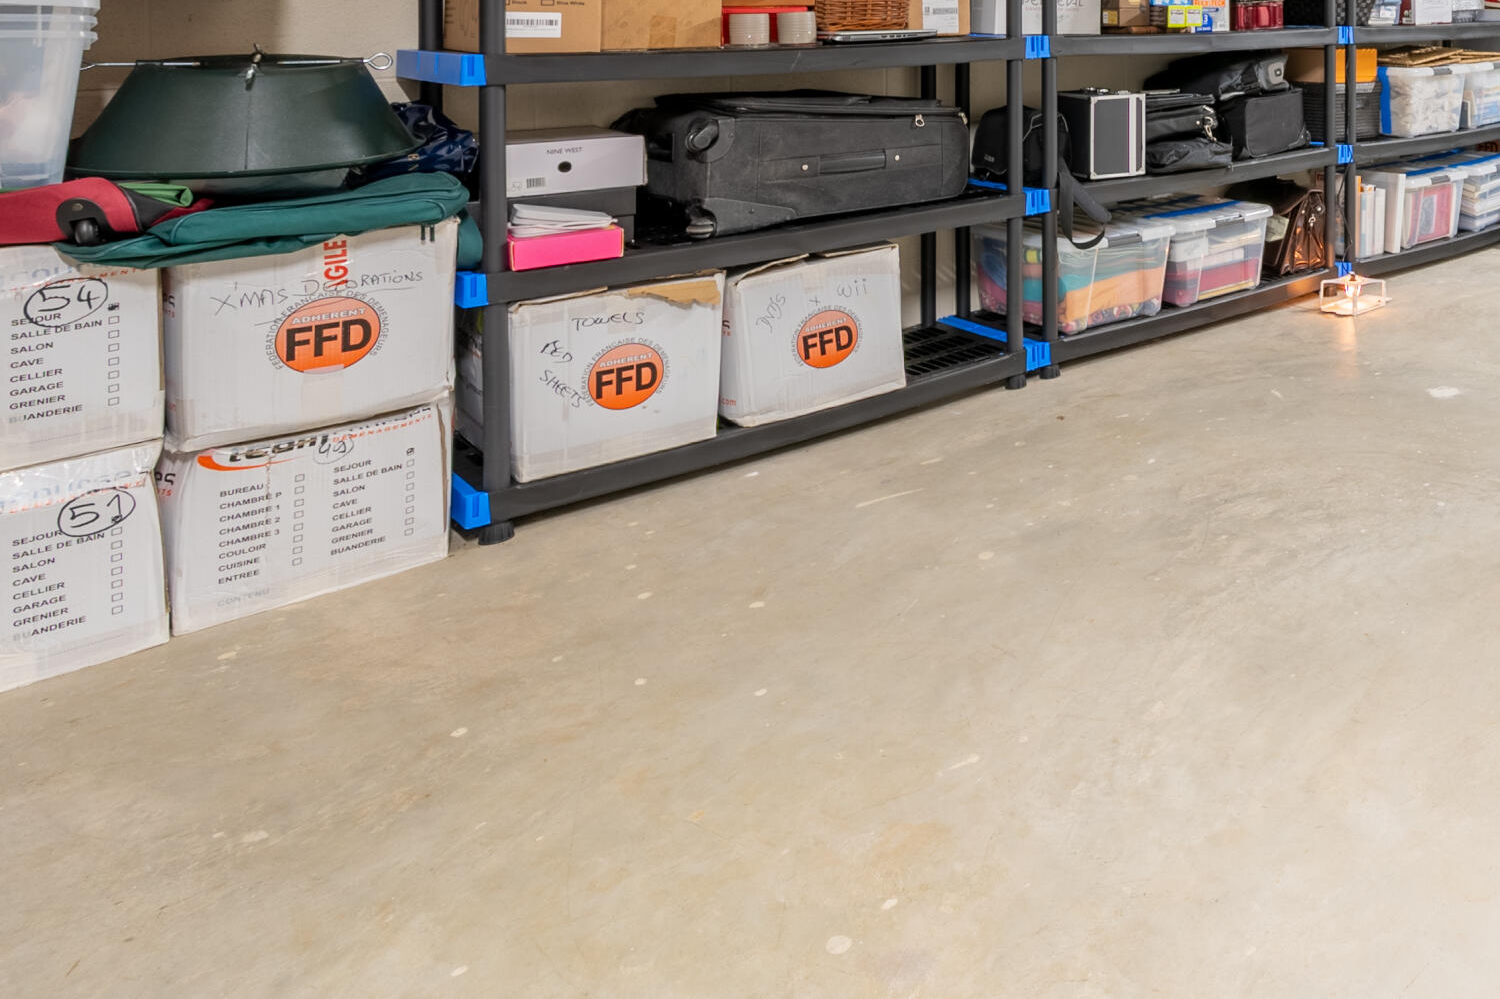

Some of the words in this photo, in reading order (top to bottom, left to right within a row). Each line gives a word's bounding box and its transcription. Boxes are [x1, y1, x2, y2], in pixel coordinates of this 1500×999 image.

[564, 146, 583, 154] WEST
[37, 284, 100, 312] 54
[11, 313, 61, 326] SEJOUR
[291, 307, 367, 325] ADHERENT
[571, 312, 645, 331] TOWELS
[11, 328, 51, 341] SALLE
[54, 324, 71, 333] DE
[74, 320, 102, 330] BAIN
[286, 318, 372, 362] FFD
[802, 325, 854, 361] FFD
[10, 342, 54, 355] SALON
[10, 358, 44, 369] CAVE
[10, 369, 63, 383] CELLIER
[595, 361, 658, 400] FFD
[10, 382, 64, 397] GARAGE
[9, 394, 66, 410] GRENIER
[333, 460, 372, 473] SEJOUR
[333, 473, 363, 485] SALLE
[366, 470, 378, 478] DE
[381, 464, 402, 474] BAIN
[220, 483, 264, 497] BUREAU
[333, 484, 365, 497] SALON
[220, 493, 272, 510] CHAMBRE
[333, 499, 358, 510] CAVE
[69, 494, 123, 528] 51
[220, 505, 272, 522] CHAMBRE
[332, 506, 372, 521] CELLIER
[219, 518, 272, 536] CHAMBRE
[332, 518, 372, 532] GARAGE
[12, 530, 62, 547] SEJOUR
[219, 530, 272, 548] CHAMBRE
[331, 529, 373, 544] GRENIER
[12, 544, 53, 560] SALLE
[56, 539, 73, 549] DE
[77, 532, 105, 544] BAIN
[219, 543, 266, 559] COULOIR
[330, 536, 386, 555] BUANDERIE
[12, 557, 55, 573] SALON
[218, 557, 260, 572] CUISINE
[12, 573, 46, 587] CAVE
[218, 569, 260, 584] ENTREE
[13, 581, 65, 601] CELLIER
[13, 594, 66, 614] GARAGE
[13, 607, 69, 627] GRENIER
